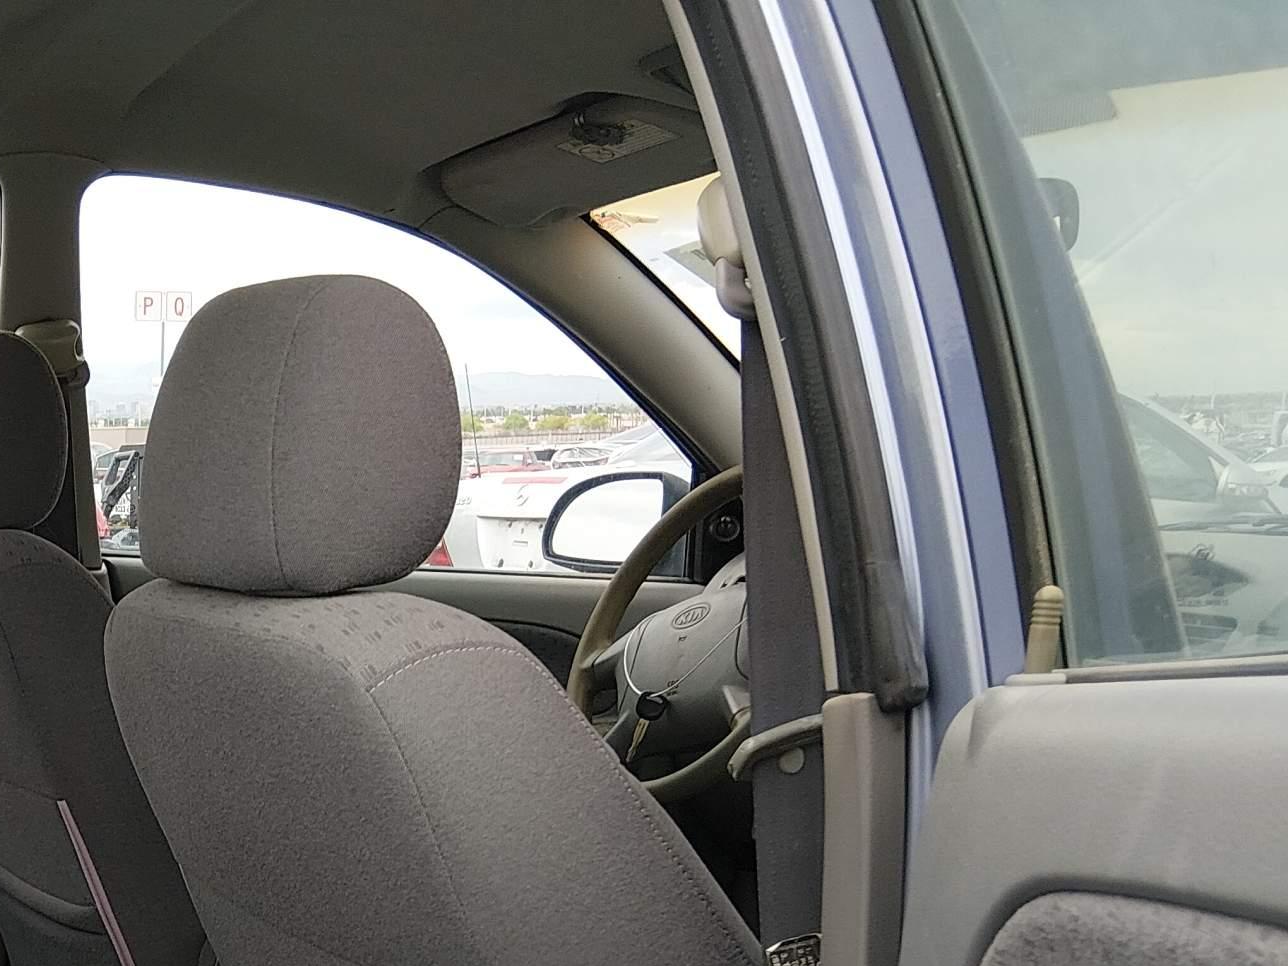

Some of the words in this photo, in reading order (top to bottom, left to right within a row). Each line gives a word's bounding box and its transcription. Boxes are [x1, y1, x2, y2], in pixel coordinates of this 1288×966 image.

[143, 296, 154, 316] P
[174, 297, 185, 317] Q
[677, 606, 706, 627] KIA
